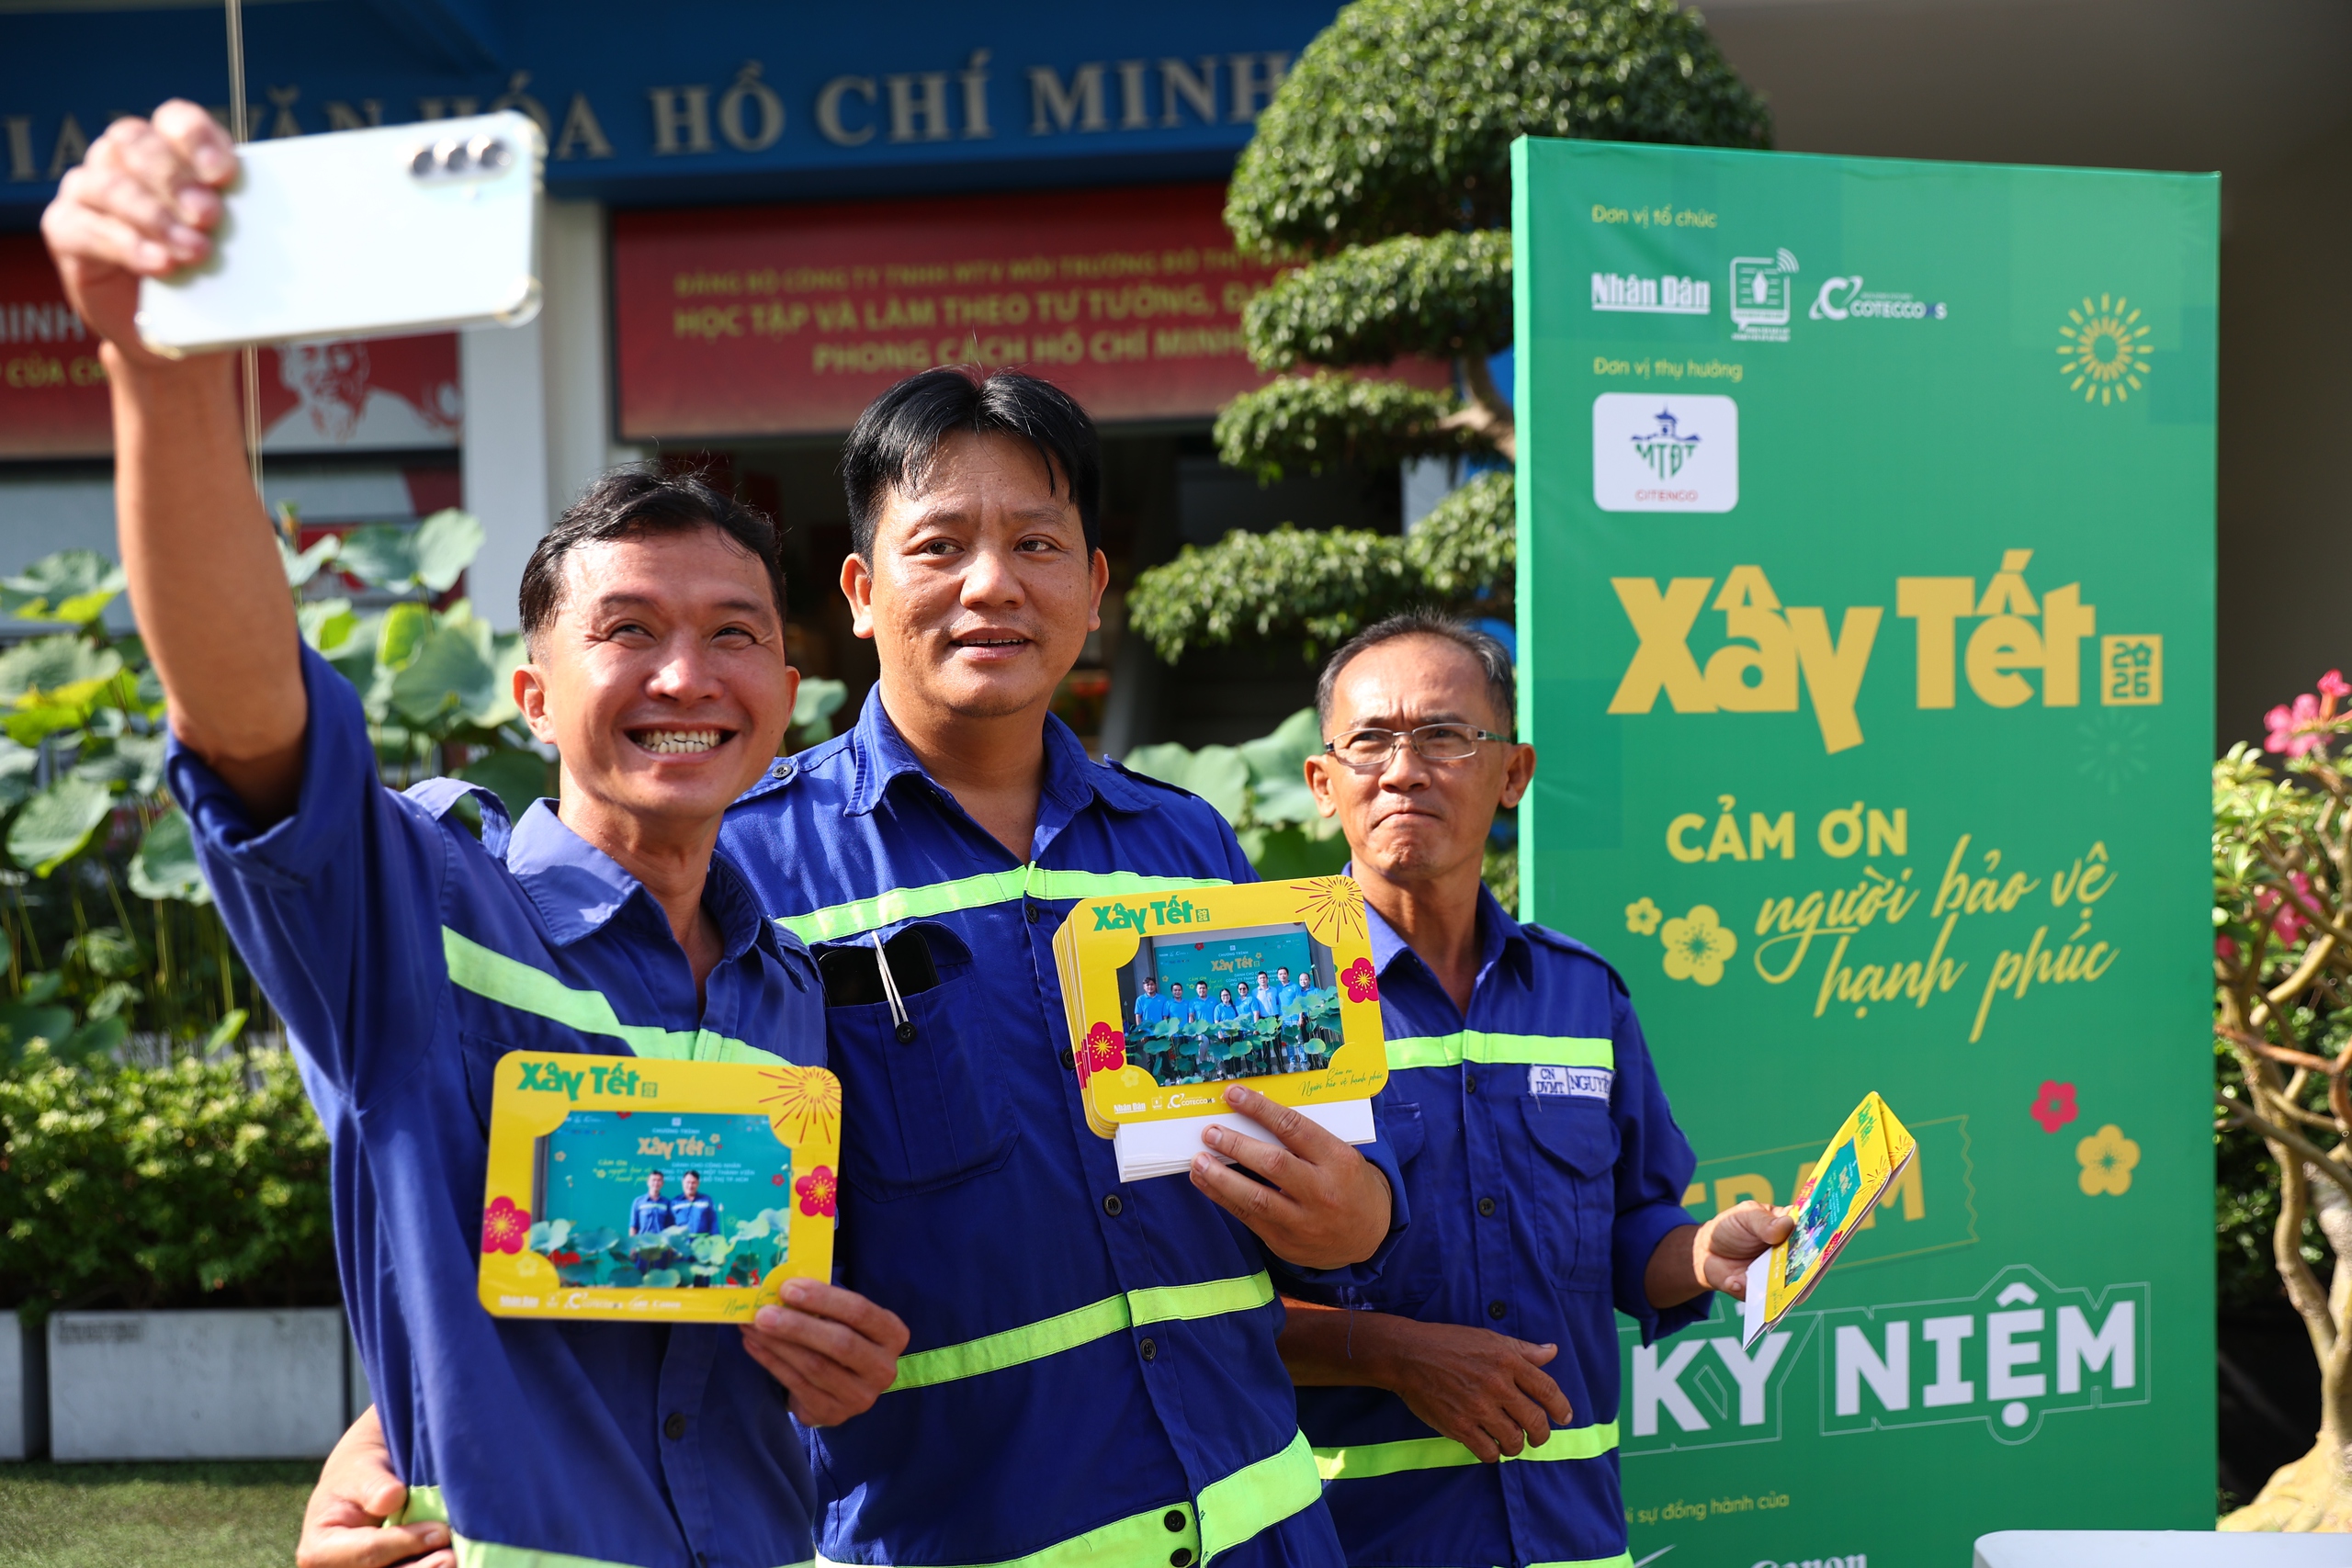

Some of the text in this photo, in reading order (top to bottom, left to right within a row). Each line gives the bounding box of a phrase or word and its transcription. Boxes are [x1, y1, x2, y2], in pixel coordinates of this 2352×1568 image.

[650, 60, 786, 157] HỒ
[816, 49, 995, 147] CHÍ
[1027, 51, 1293, 138] MINH
[1591, 203, 1718, 229] Đơn vị tổ chức
[1591, 272, 1711, 308] Nhân Dân
[0, 302, 87, 344] INH
[673, 305, 744, 344] HỌC
[749, 298, 811, 342] TẬP
[813, 296, 858, 333] VÀ
[864, 293, 936, 332] LÀM
[941, 290, 1030, 327] THEO
[1035, 288, 1080, 322] TƯ
[812, 338, 931, 375] PHONG
[935, 327, 1026, 369] CÁCH
[1033, 325, 1085, 366] HỒ
[1090, 321, 1148, 364] CHÍ
[1593, 356, 1630, 376] Đơn
[1634, 356, 1650, 380] vị
[1655, 358, 1683, 381] thụ
[1606, 548, 2097, 755] Xây Tết
[1665, 794, 1908, 863] CẢM ƠN
[1091, 895, 1193, 935] Xây Tết
[1753, 833, 2119, 984] người bảo vệ
[1211, 955, 1253, 973] Xây Tết
[1813, 913, 2123, 1043] hạnh phúc
[516, 1060, 585, 1101] Xây
[589, 1061, 640, 1097] Tết
[1541, 1068, 1556, 1080] CN
[1114, 1102, 1132, 1112] Nhân
[1133, 1101, 1146, 1111] Dân
[637, 1134, 706, 1160] Xây Tết
[1834, 1280, 2137, 1428] NIỆM
